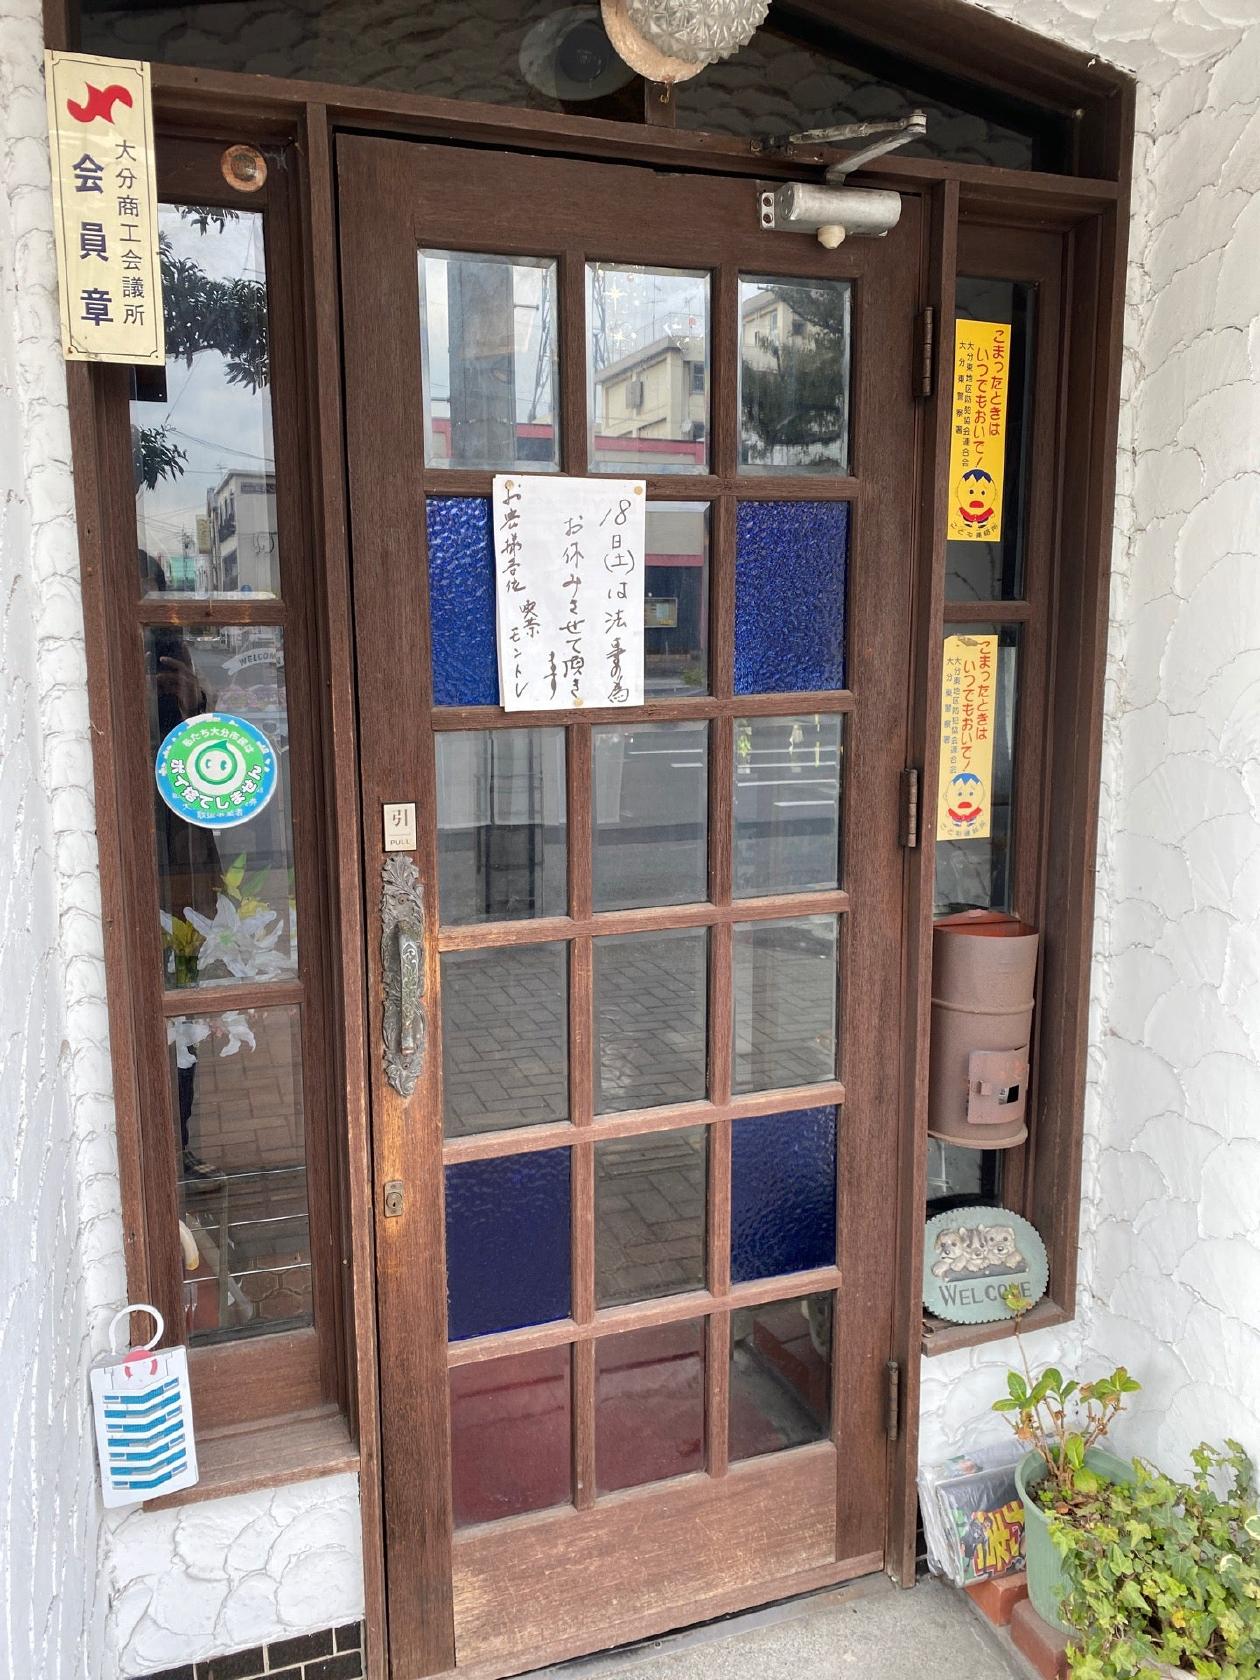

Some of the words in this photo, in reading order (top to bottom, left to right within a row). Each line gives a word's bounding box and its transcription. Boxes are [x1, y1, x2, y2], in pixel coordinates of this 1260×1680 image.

[72, 153, 114, 327] 会員章
[114, 139, 145, 326] 大分商工会議所
[988, 329, 1005, 436] こまったときは
[975, 640, 991, 741] こまったときは
[170, 759, 263, 809] ポイ捨てしません
[391, 808, 408, 827] 引
[390, 838, 411, 846] PULL
[938, 1281, 1033, 1307] WELCOE
